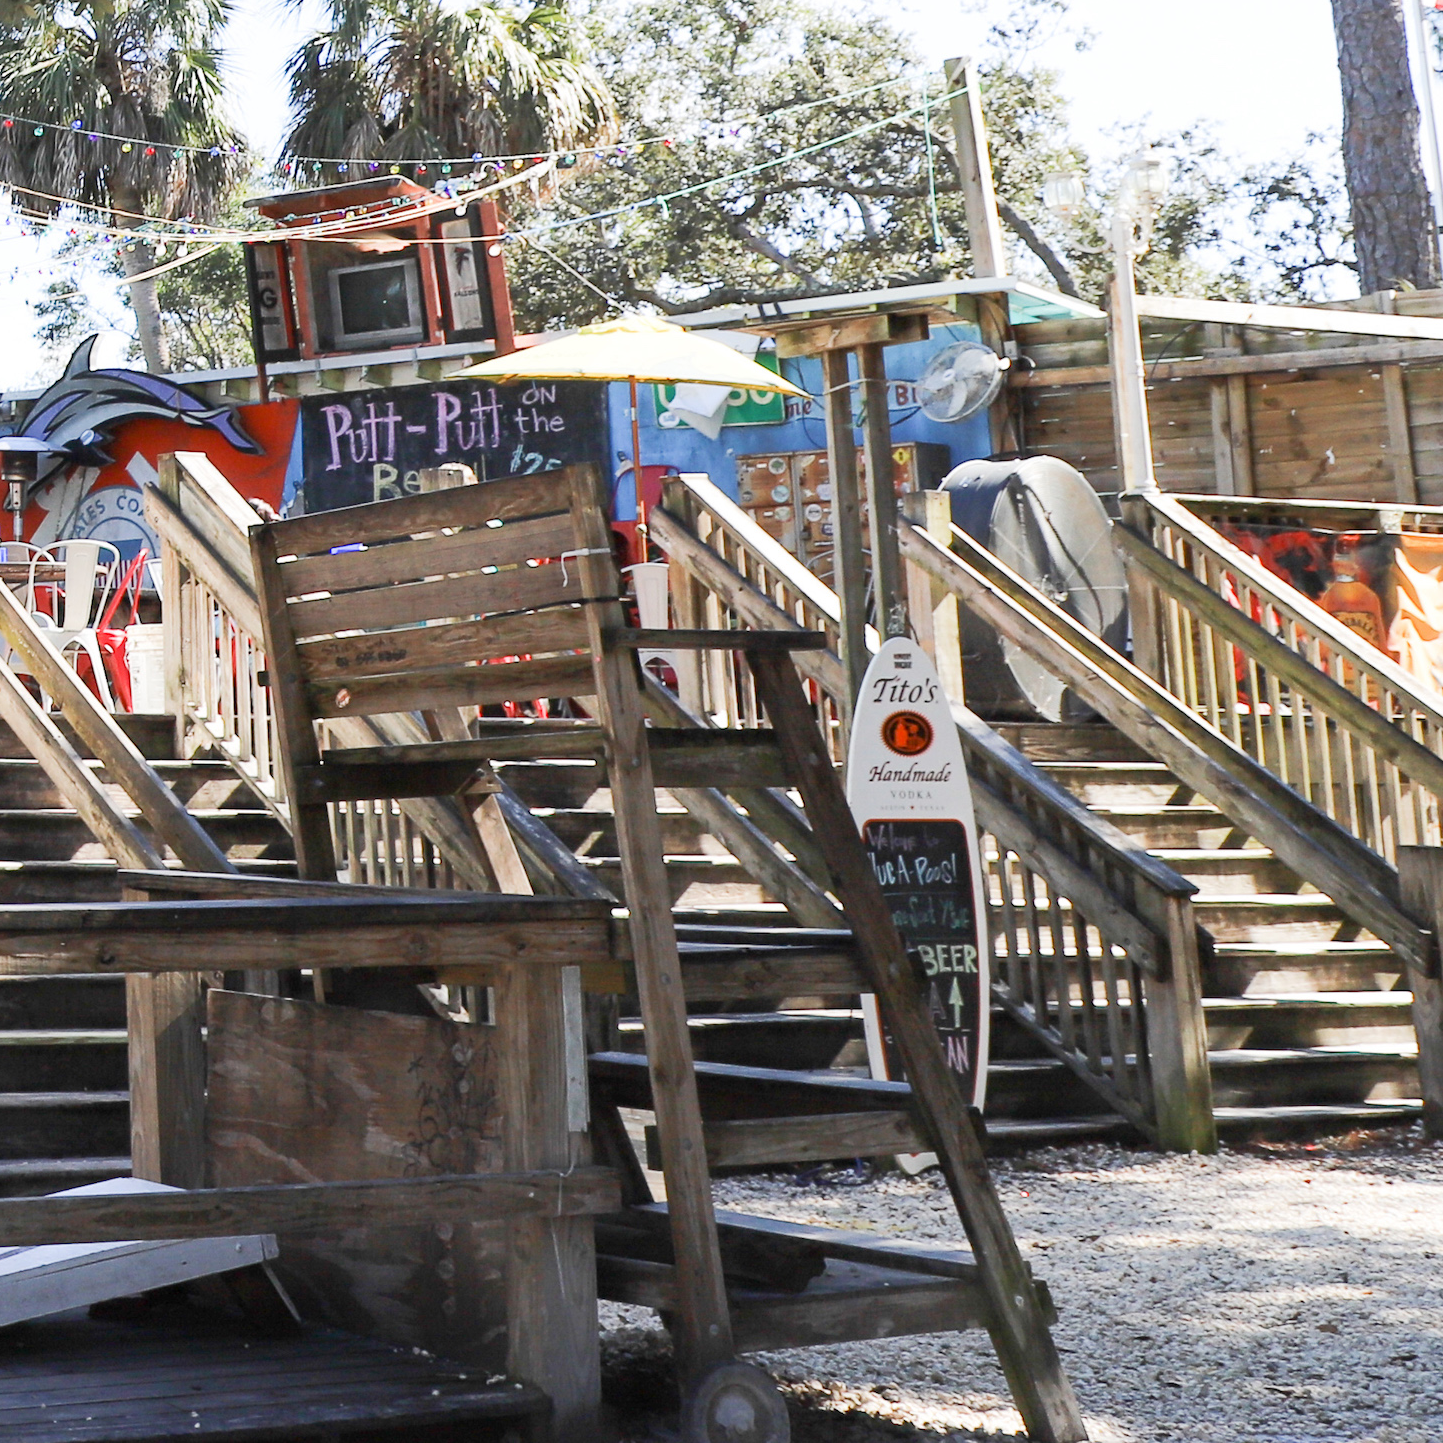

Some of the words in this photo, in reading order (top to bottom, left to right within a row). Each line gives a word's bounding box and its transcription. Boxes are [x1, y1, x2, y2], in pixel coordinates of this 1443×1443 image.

[320, 388, 504, 472] Putt-Putt
[515, 407, 566, 434] the
[74, 499, 106, 538] ATES
[872, 674, 938, 704] Tito's
[868, 760, 952, 783] Handmade
[890, 790, 933, 800] VODKA
[917, 944, 979, 977] BEER
